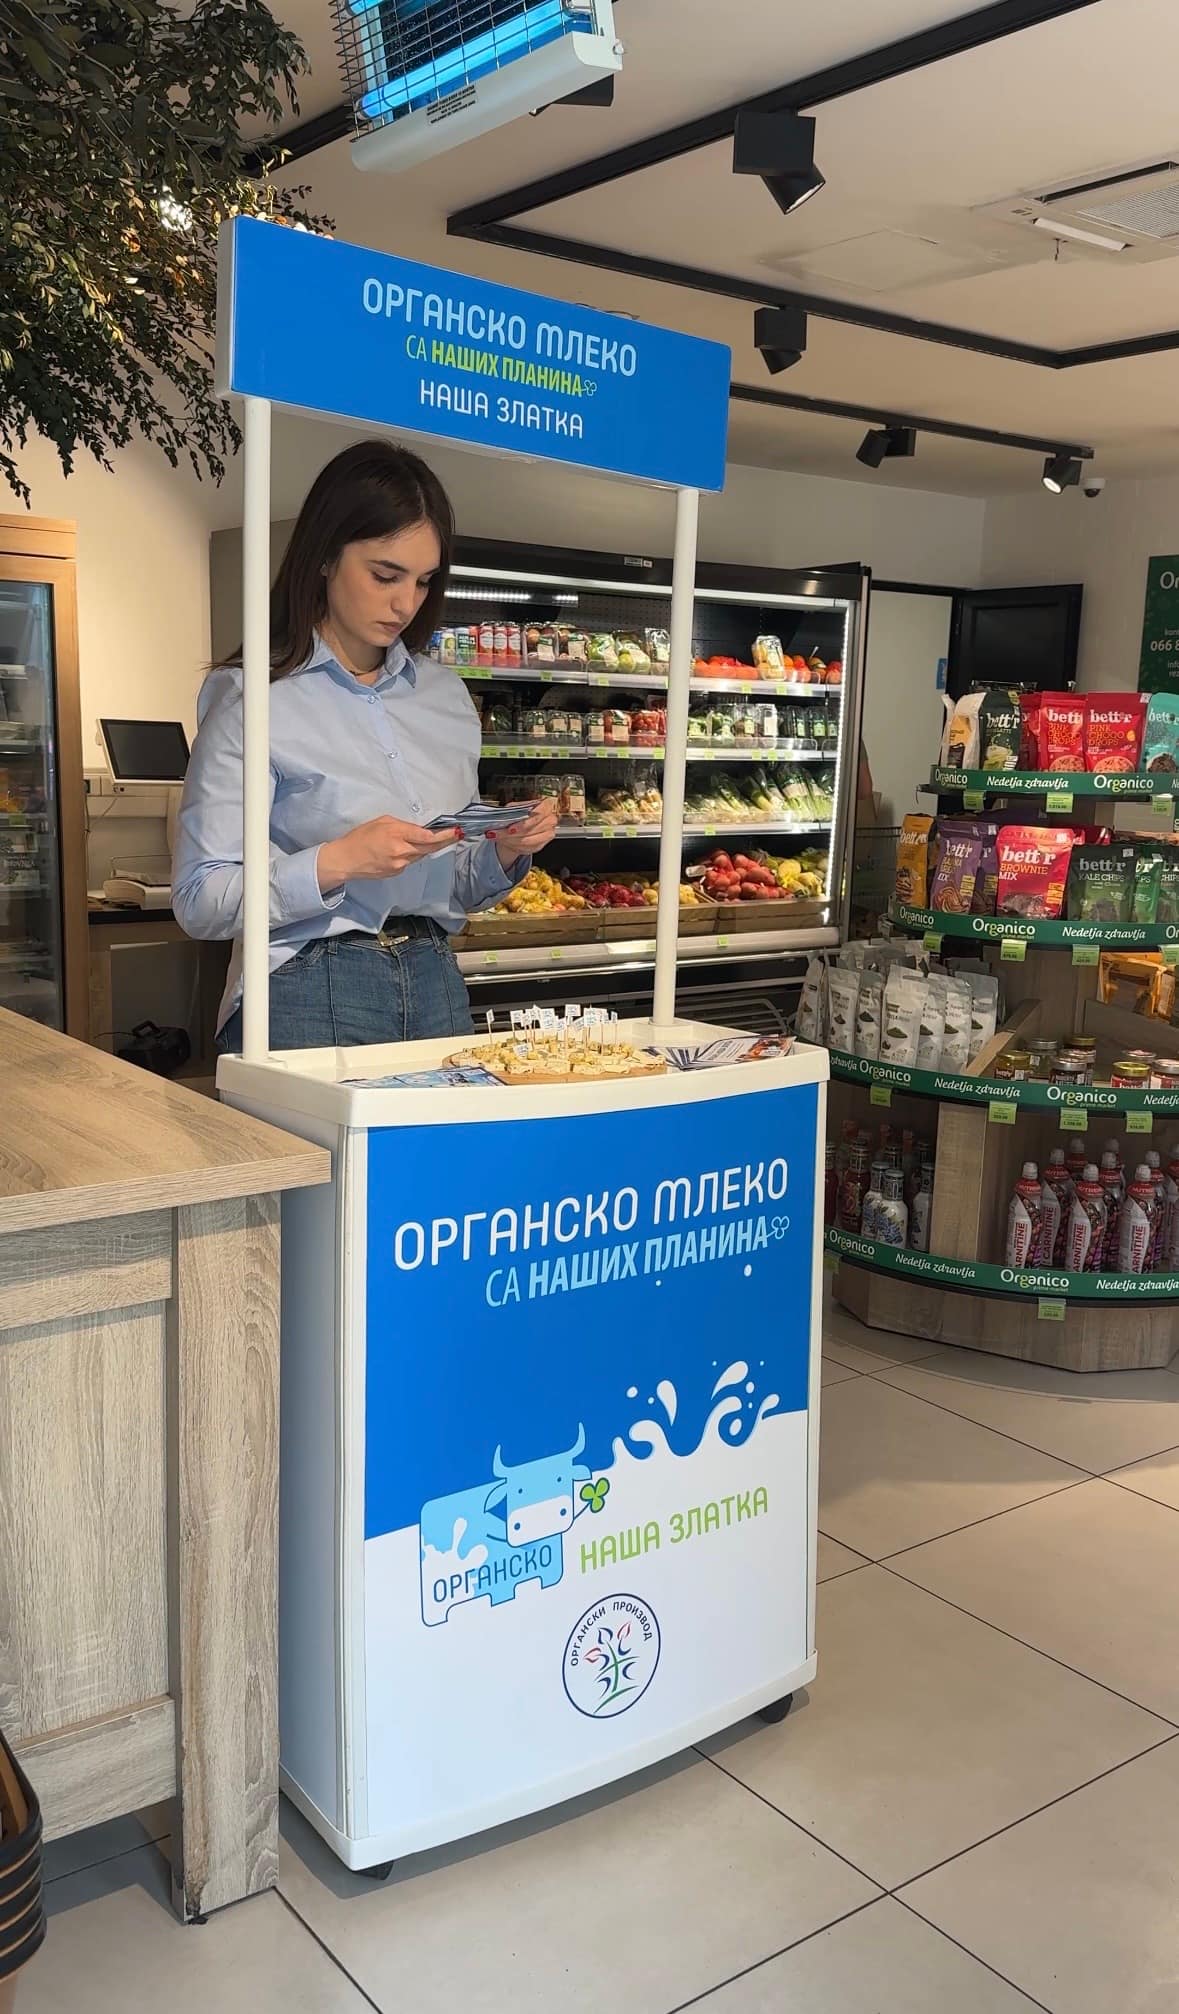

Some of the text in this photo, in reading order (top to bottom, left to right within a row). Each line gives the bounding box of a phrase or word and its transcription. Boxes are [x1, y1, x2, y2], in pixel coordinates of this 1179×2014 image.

[362, 277, 637, 378] ОРГАНСКО МЛЕКО
[405, 334, 583, 399] СА НАШИХ ПЛАНИНА
[420, 379, 584, 440] НАША ЗЛАТКА
[1150, 639, 1172, 651] 066
[1088, 723, 1112, 732] PINK
[1088, 730, 1125, 739] CHOCO
[1088, 738, 1119, 747] DROPS
[935, 768, 968, 785] Organico
[986, 775, 1069, 791] Nedelja zdravlja
[1093, 774, 1154, 793] Organico
[998, 872, 1018, 881] MIX
[1000, 863, 1049, 876] BROWNIE
[1078, 873, 1101, 882] KALE
[899, 905, 935, 926] Organico
[972, 918, 1036, 937] Organico
[1062, 926, 1147, 941] Nedelja zdravlja
[859, 1059, 912, 1083] Organico
[934, 1077, 1022, 1099] Nedelja zdravlja
[1047, 1086, 1117, 1106] Organico
[394, 1157, 788, 1271] ОРГАНСКО МЛЕКО
[829, 1229, 875, 1255] Organico
[485, 1214, 769, 1308] СА НАШИХ ПЛАНИНА
[895, 1253, 976, 1280] Nedelja zdravlja
[1000, 1269, 1070, 1289] Organico
[1096, 1278, 1179, 1292] Nedelja zdravlja
[580, 1486, 769, 1575] НАША ЗЛАТКА
[433, 1544, 552, 1604] ОРГАНСКО
[569, 1600, 654, 1667] ОРГАНСКИ ПРОИЗВОД
